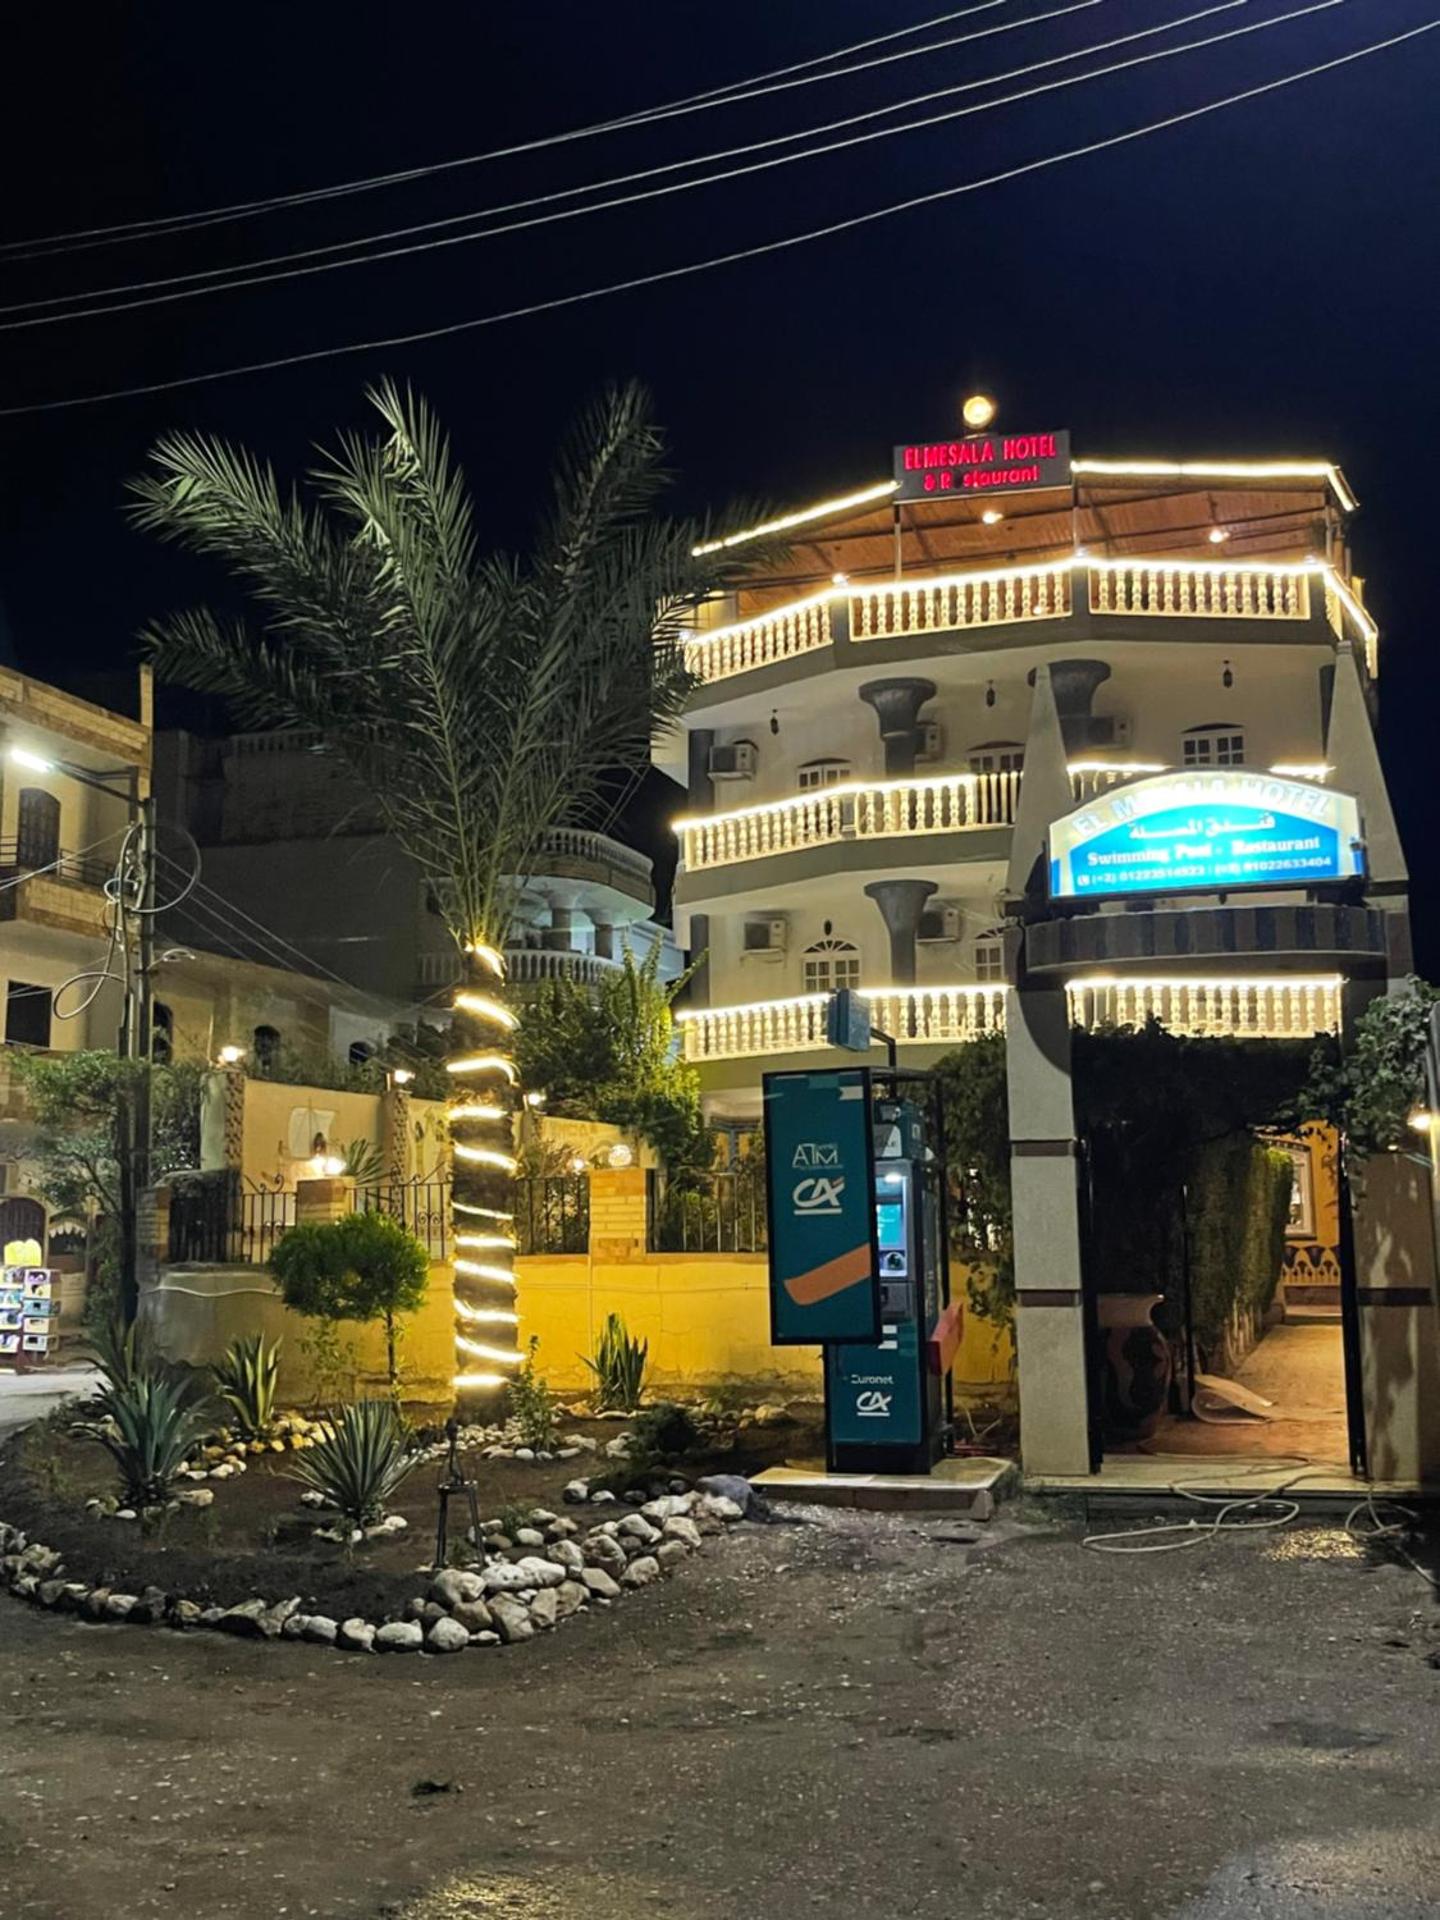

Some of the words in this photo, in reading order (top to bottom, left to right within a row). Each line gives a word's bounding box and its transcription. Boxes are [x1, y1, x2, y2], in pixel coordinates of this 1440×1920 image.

[1003, 434, 1057, 462] HOTEL
[940, 465, 1040, 490] Rstaurant
[1241, 776, 1331, 817] HOTEL
[1087, 847, 1170, 867] Swimming
[1231, 836, 1320, 856] Restaurant
[791, 1143, 839, 1168] ATM
[792, 1176, 845, 1208] CA
[856, 1390, 892, 1412] CA
